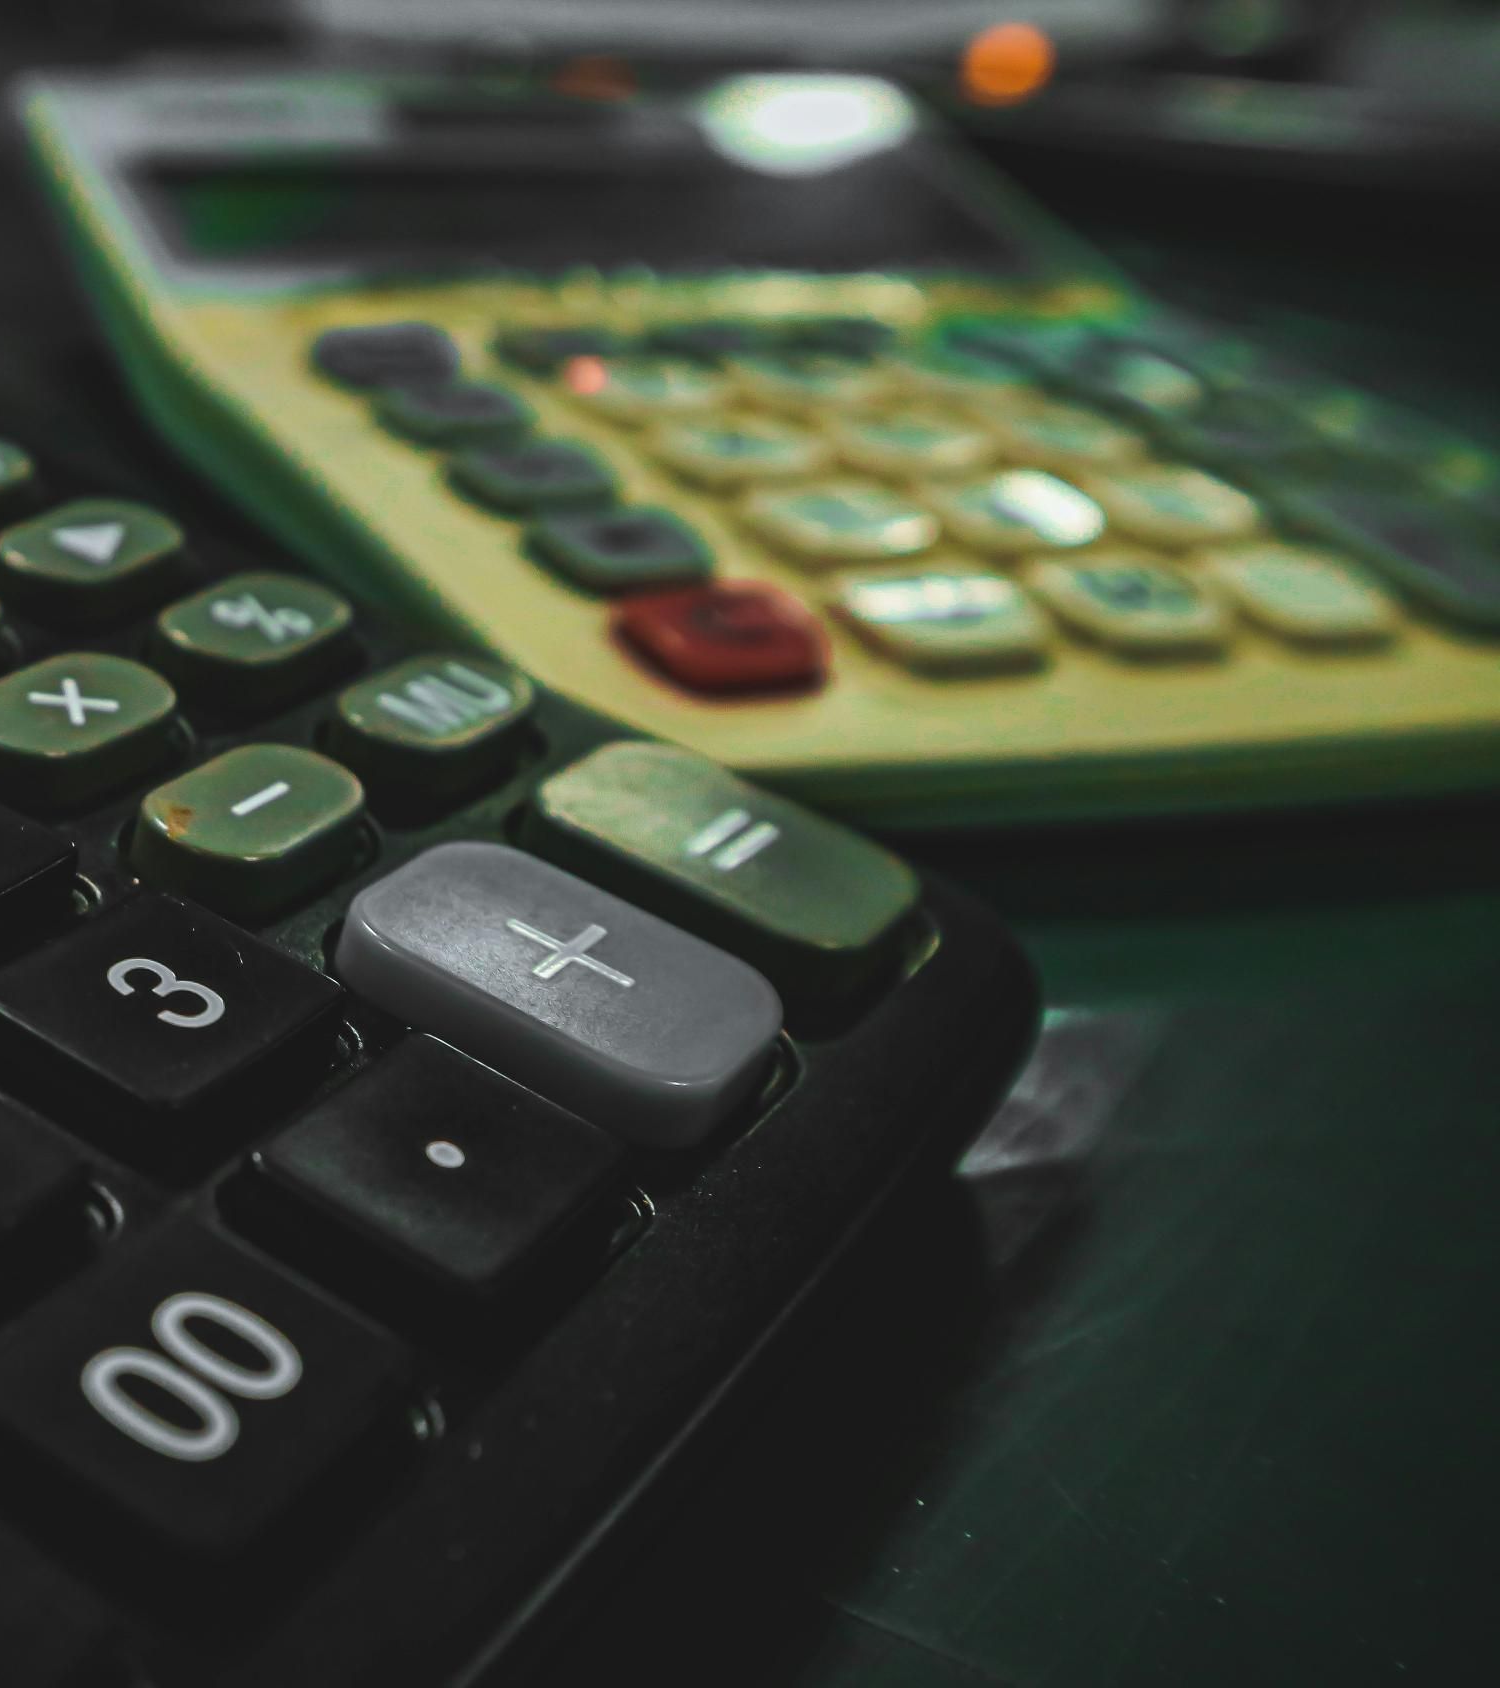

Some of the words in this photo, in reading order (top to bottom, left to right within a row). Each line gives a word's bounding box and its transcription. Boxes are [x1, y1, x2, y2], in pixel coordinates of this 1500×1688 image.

[378, 661, 512, 734] MU
[106, 958, 226, 1028] 3
[81, 1292, 302, 1462] 00
